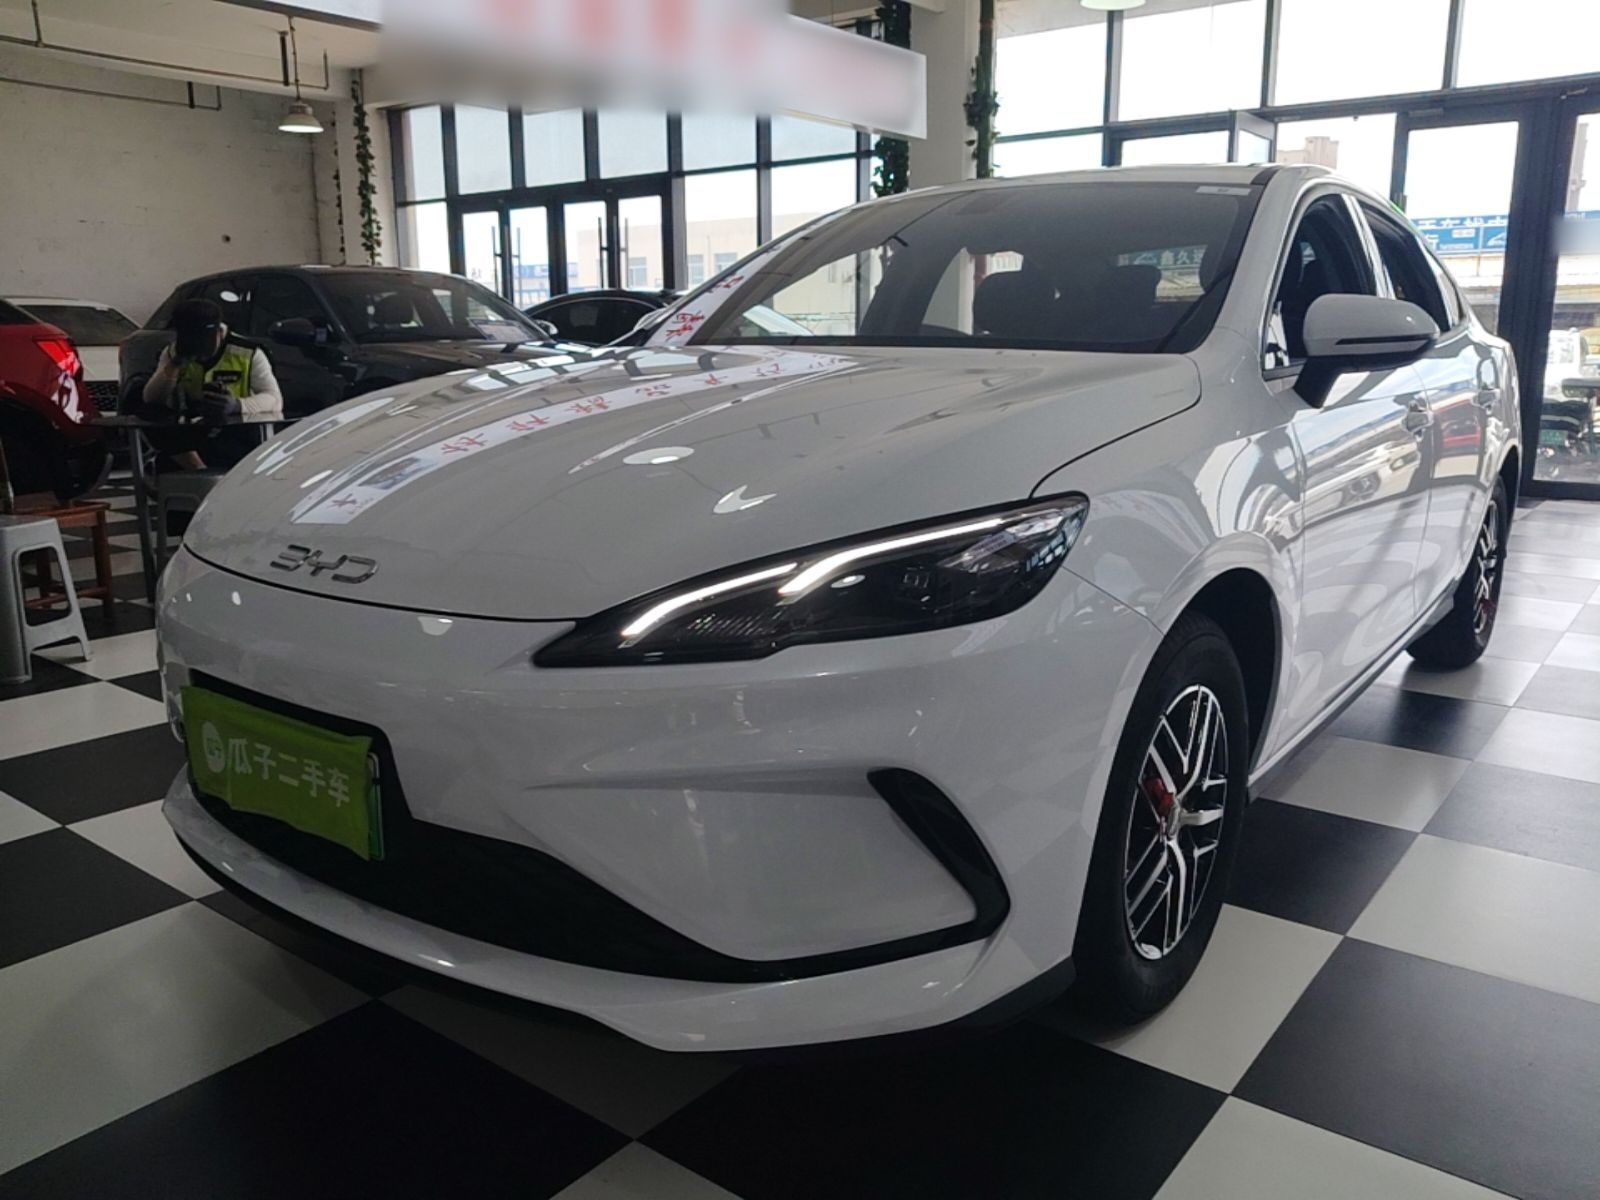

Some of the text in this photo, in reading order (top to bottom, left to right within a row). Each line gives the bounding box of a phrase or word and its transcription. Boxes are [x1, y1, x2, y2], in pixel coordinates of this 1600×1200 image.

[270, 544, 379, 584] BYD
[227, 738, 350, 808] 瓜子二手车
